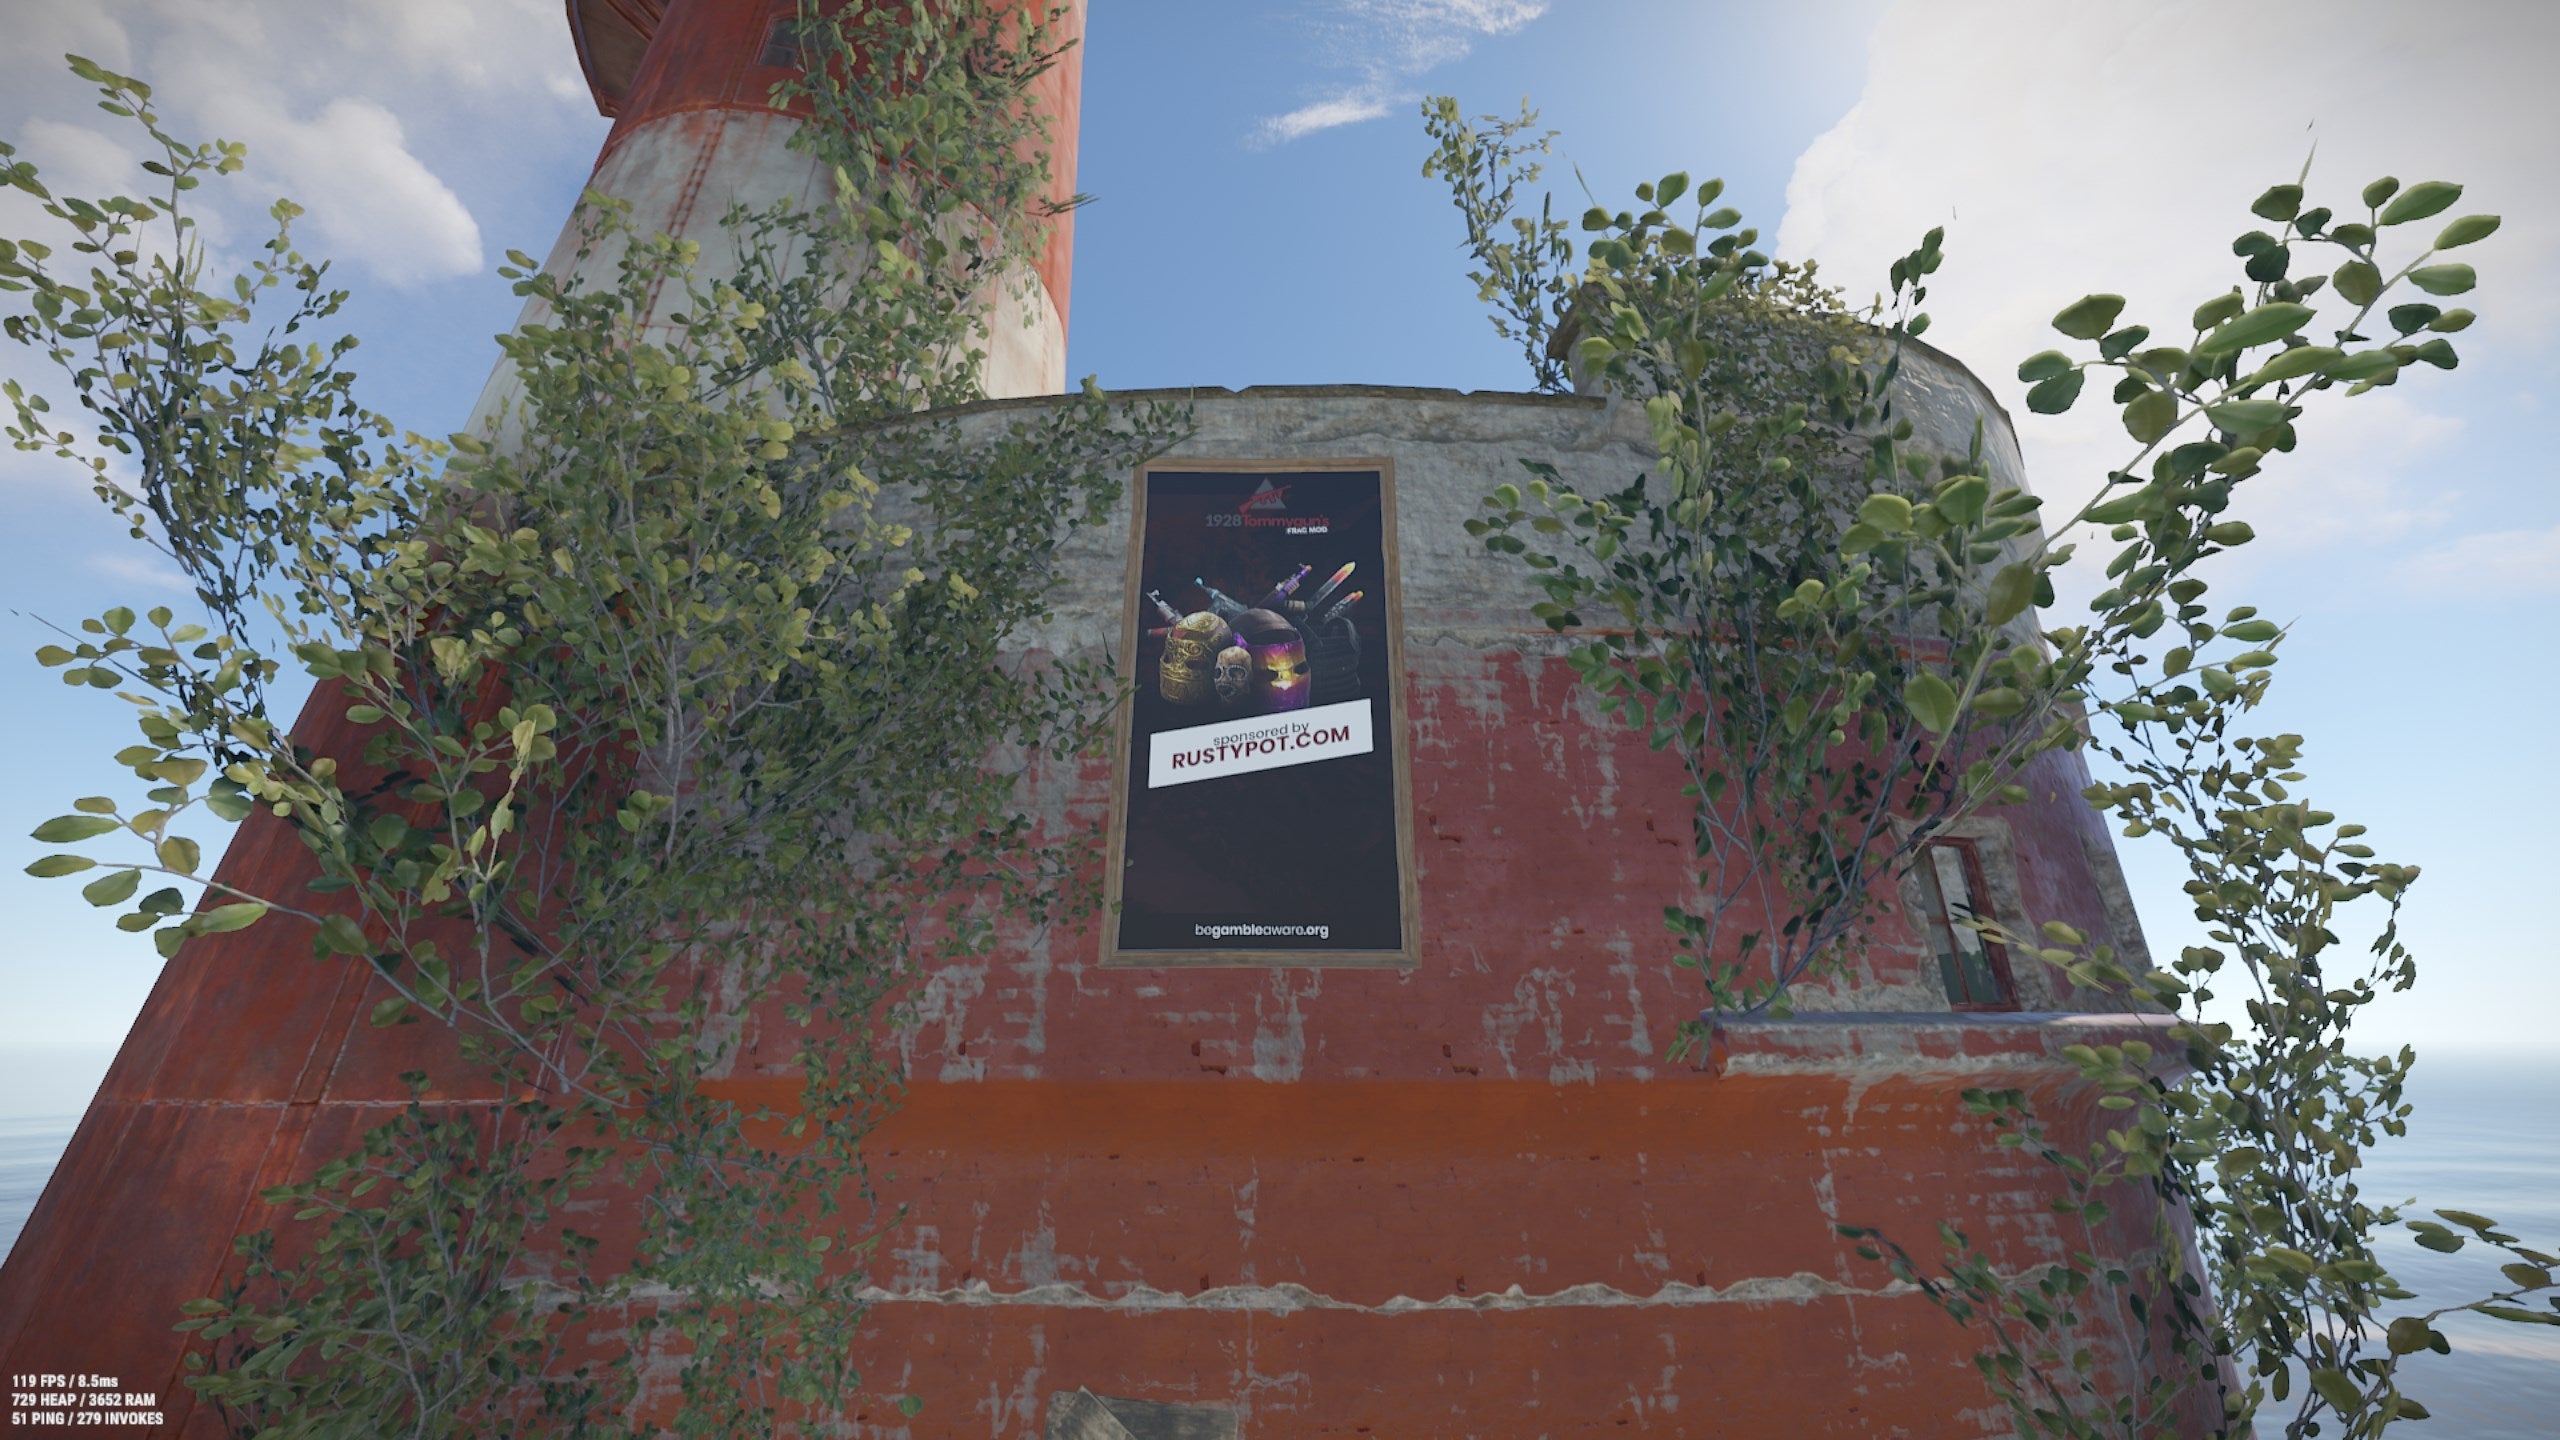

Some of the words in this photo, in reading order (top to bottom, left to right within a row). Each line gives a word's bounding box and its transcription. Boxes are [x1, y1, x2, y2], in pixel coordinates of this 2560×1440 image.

[1309, 525, 1328, 534] MOD
[1213, 723, 1288, 746] sponsored
[1292, 722, 1310, 735] by
[1172, 725, 1350, 769] RUSTYPOT.COM
[1195, 923, 1329, 939] begambleaware.org
